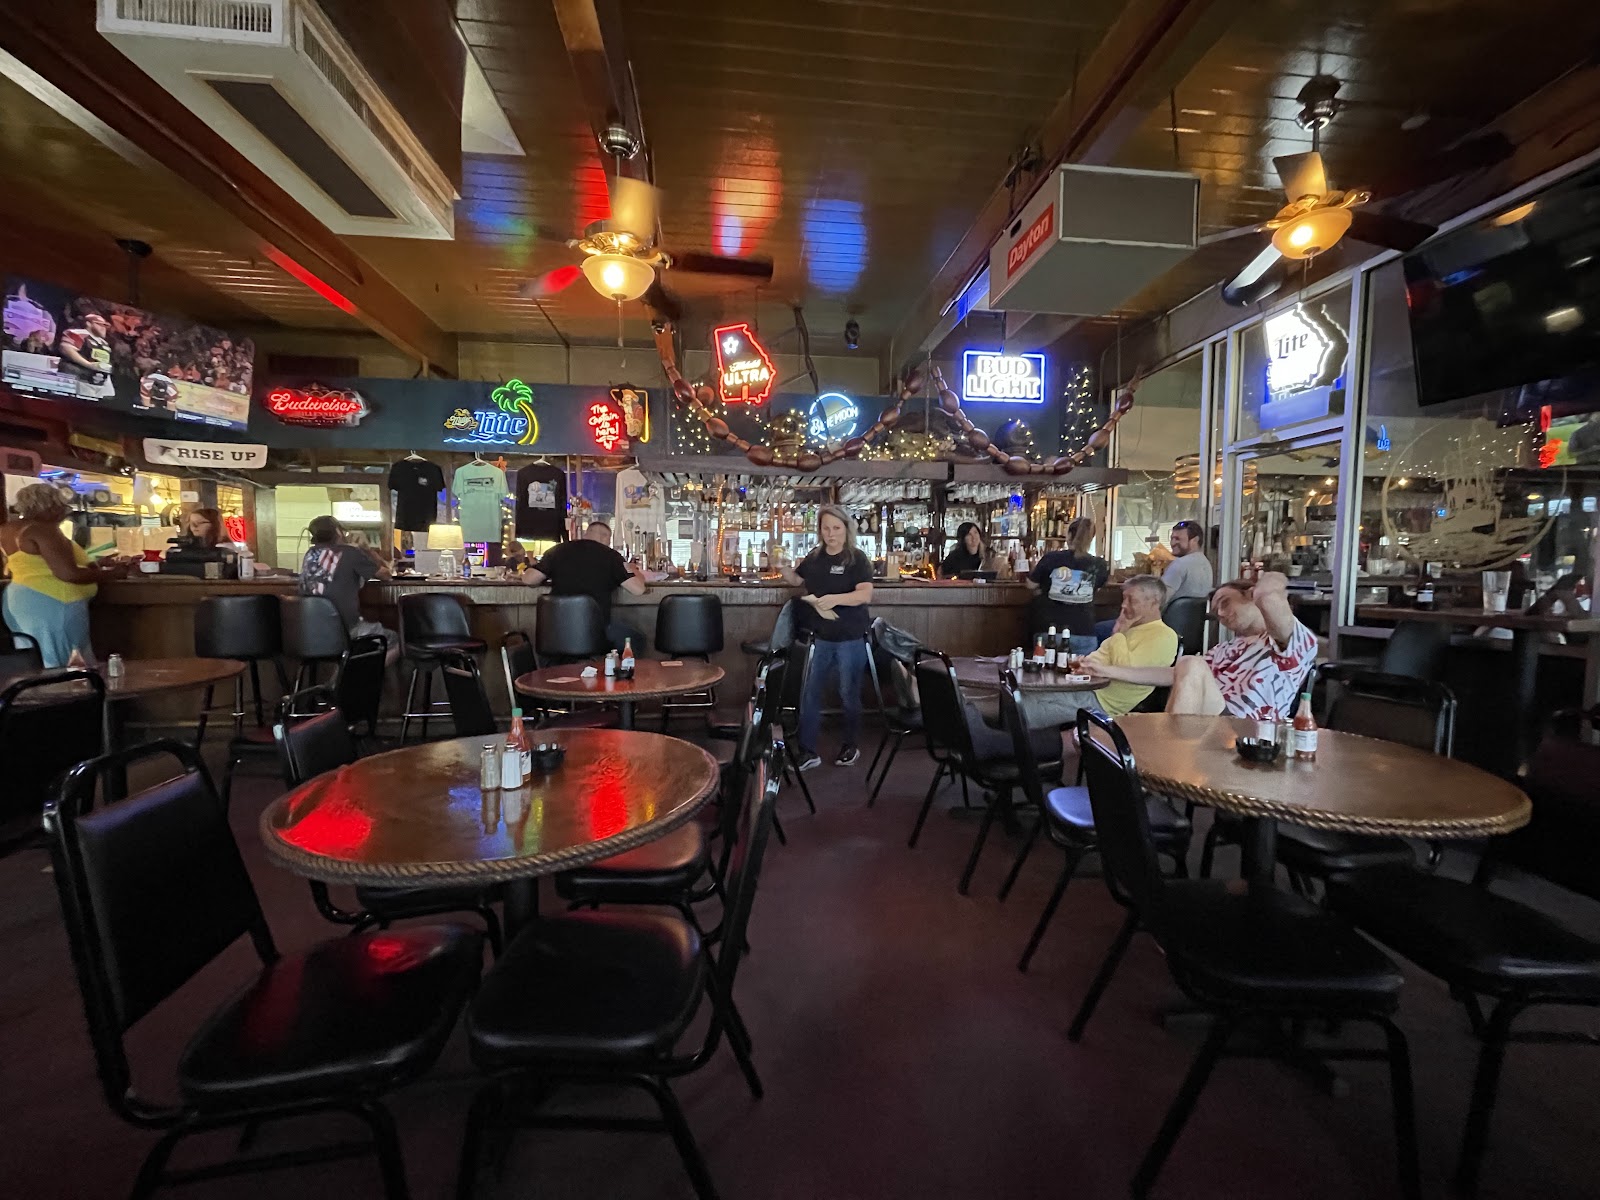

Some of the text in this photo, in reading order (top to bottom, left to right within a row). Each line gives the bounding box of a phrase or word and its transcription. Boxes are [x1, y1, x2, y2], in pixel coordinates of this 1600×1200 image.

[1009, 215, 1049, 269] Dayton
[1275, 333, 1308, 359] Lite
[724, 367, 770, 386] ULTRA
[978, 357, 1030, 377] BUD
[967, 376, 1040, 398] LIGHT
[270, 393, 356, 411] Budweiser
[590, 404, 608, 414] The
[474, 411, 528, 438] Lite
[834, 406, 858, 425] MOON
[177, 447, 256, 461] RISE UP
